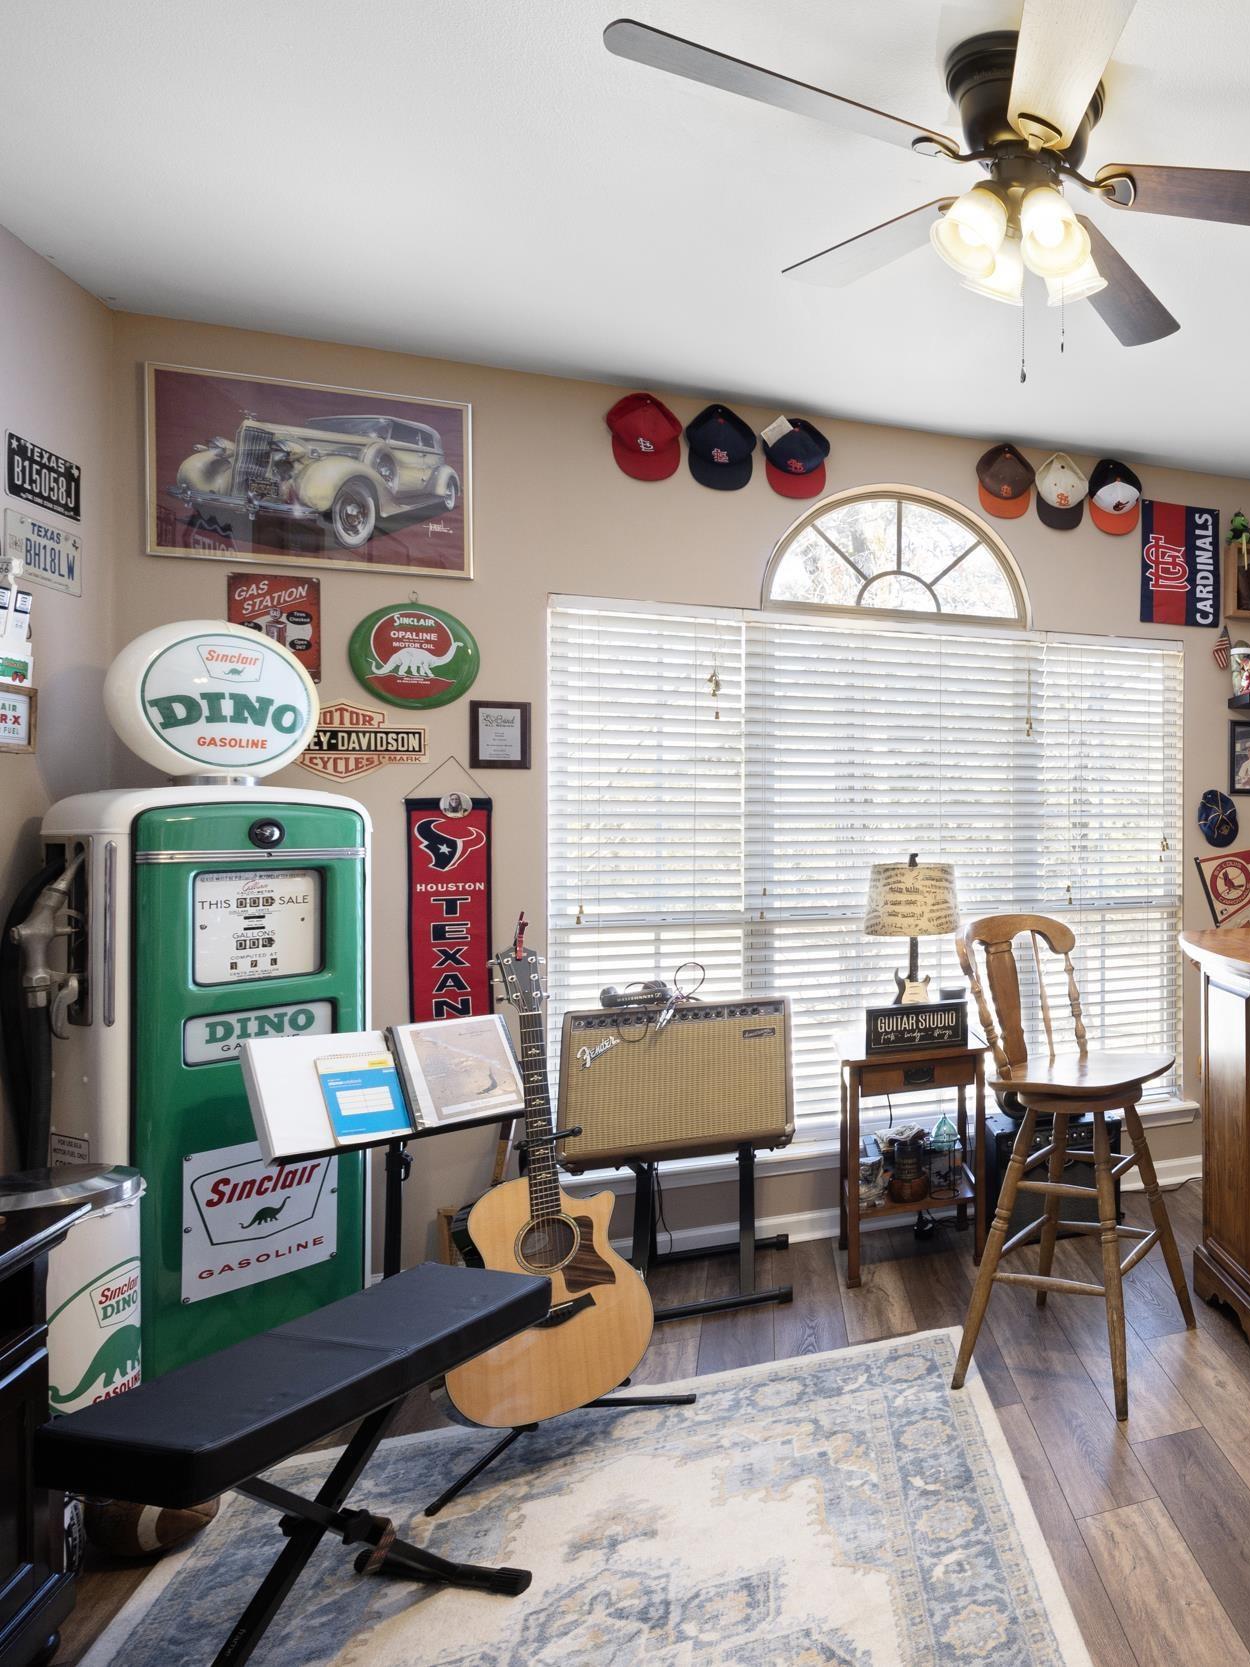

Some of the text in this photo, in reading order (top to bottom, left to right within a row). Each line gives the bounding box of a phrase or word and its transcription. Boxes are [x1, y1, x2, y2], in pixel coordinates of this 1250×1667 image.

[26, 442, 65, 473] TEXAS
[14, 455, 75, 508] B15058J
[31, 522, 61, 545] TEXAS
[25, 537, 75, 581] BH18LW
[1195, 512, 1214, 625] CARDINALS
[234, 580, 269, 601] GAS
[242, 584, 308, 614] STATION
[393, 614, 435, 626] SINCLAIR
[390, 630, 438, 640] OPALINE
[205, 649, 259, 666] Sinclair
[147, 692, 304, 734] DINO
[319, 706, 375, 727] OTOR
[197, 736, 268, 750] GASOLINE
[309, 731, 420, 752] EY-DAVIDSON
[308, 756, 375, 774] CYCLES
[416, 882, 485, 892] HOUSTON
[198, 899, 231, 910] THIS
[279, 895, 309, 905] SALE
[232, 930, 276, 939] GALLONS
[230, 952, 267, 960] COMPUTED
[431, 896, 472, 1019] TEXAN
[205, 1008, 316, 1045] DINO
[877, 1011, 956, 1033] GUITAR STUDIO
[577, 1036, 621, 1069] Fender
[206, 1162, 321, 1208] Sinclair
[198, 1235, 324, 1280] GASOLINE
[101, 1288, 138, 1322] DINO
